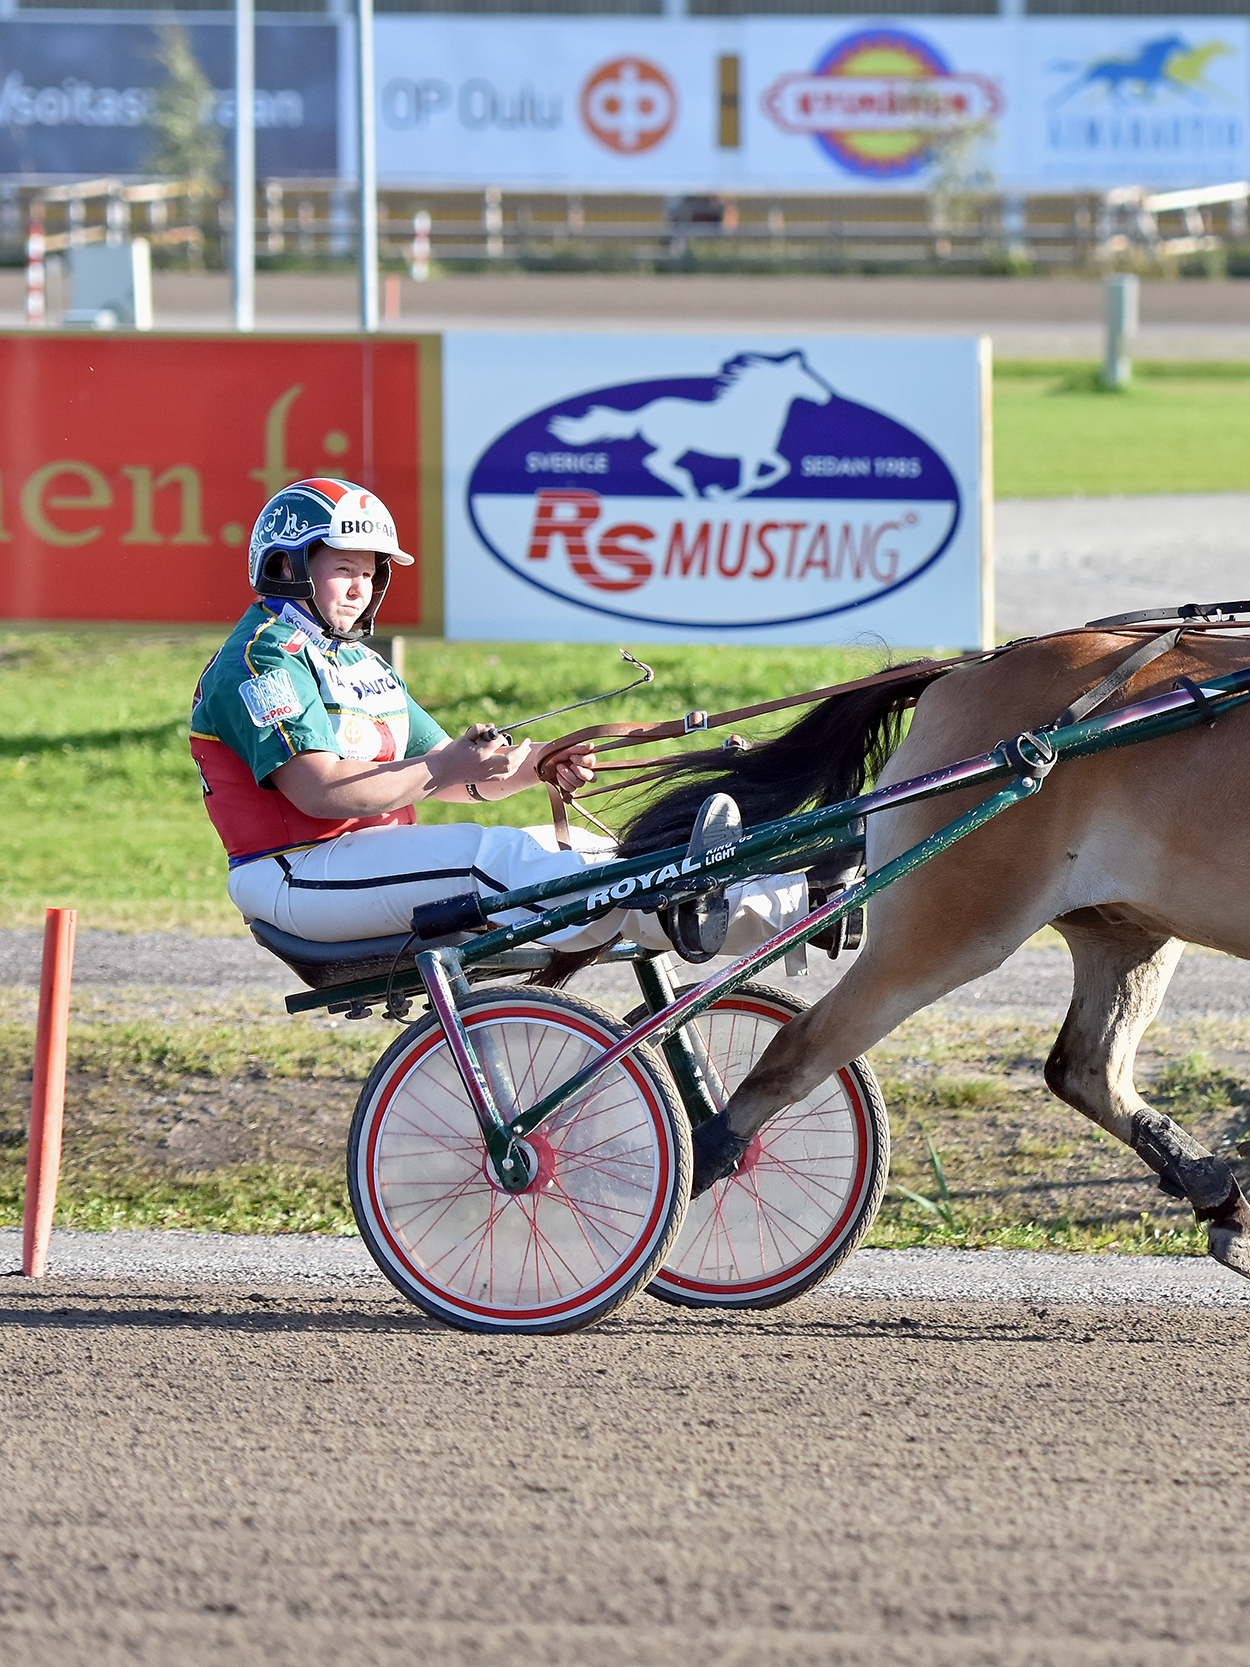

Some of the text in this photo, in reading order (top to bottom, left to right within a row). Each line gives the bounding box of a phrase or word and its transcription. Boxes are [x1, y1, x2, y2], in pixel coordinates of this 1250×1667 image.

[381, 77, 564, 131] OP Oulu
[526, 452, 922, 479] SVERIGE SEDAN 1985
[527, 488, 657, 593] RS
[269, 705, 292, 719] PRO
[586, 846, 737, 911] ROYAL LIGHT
